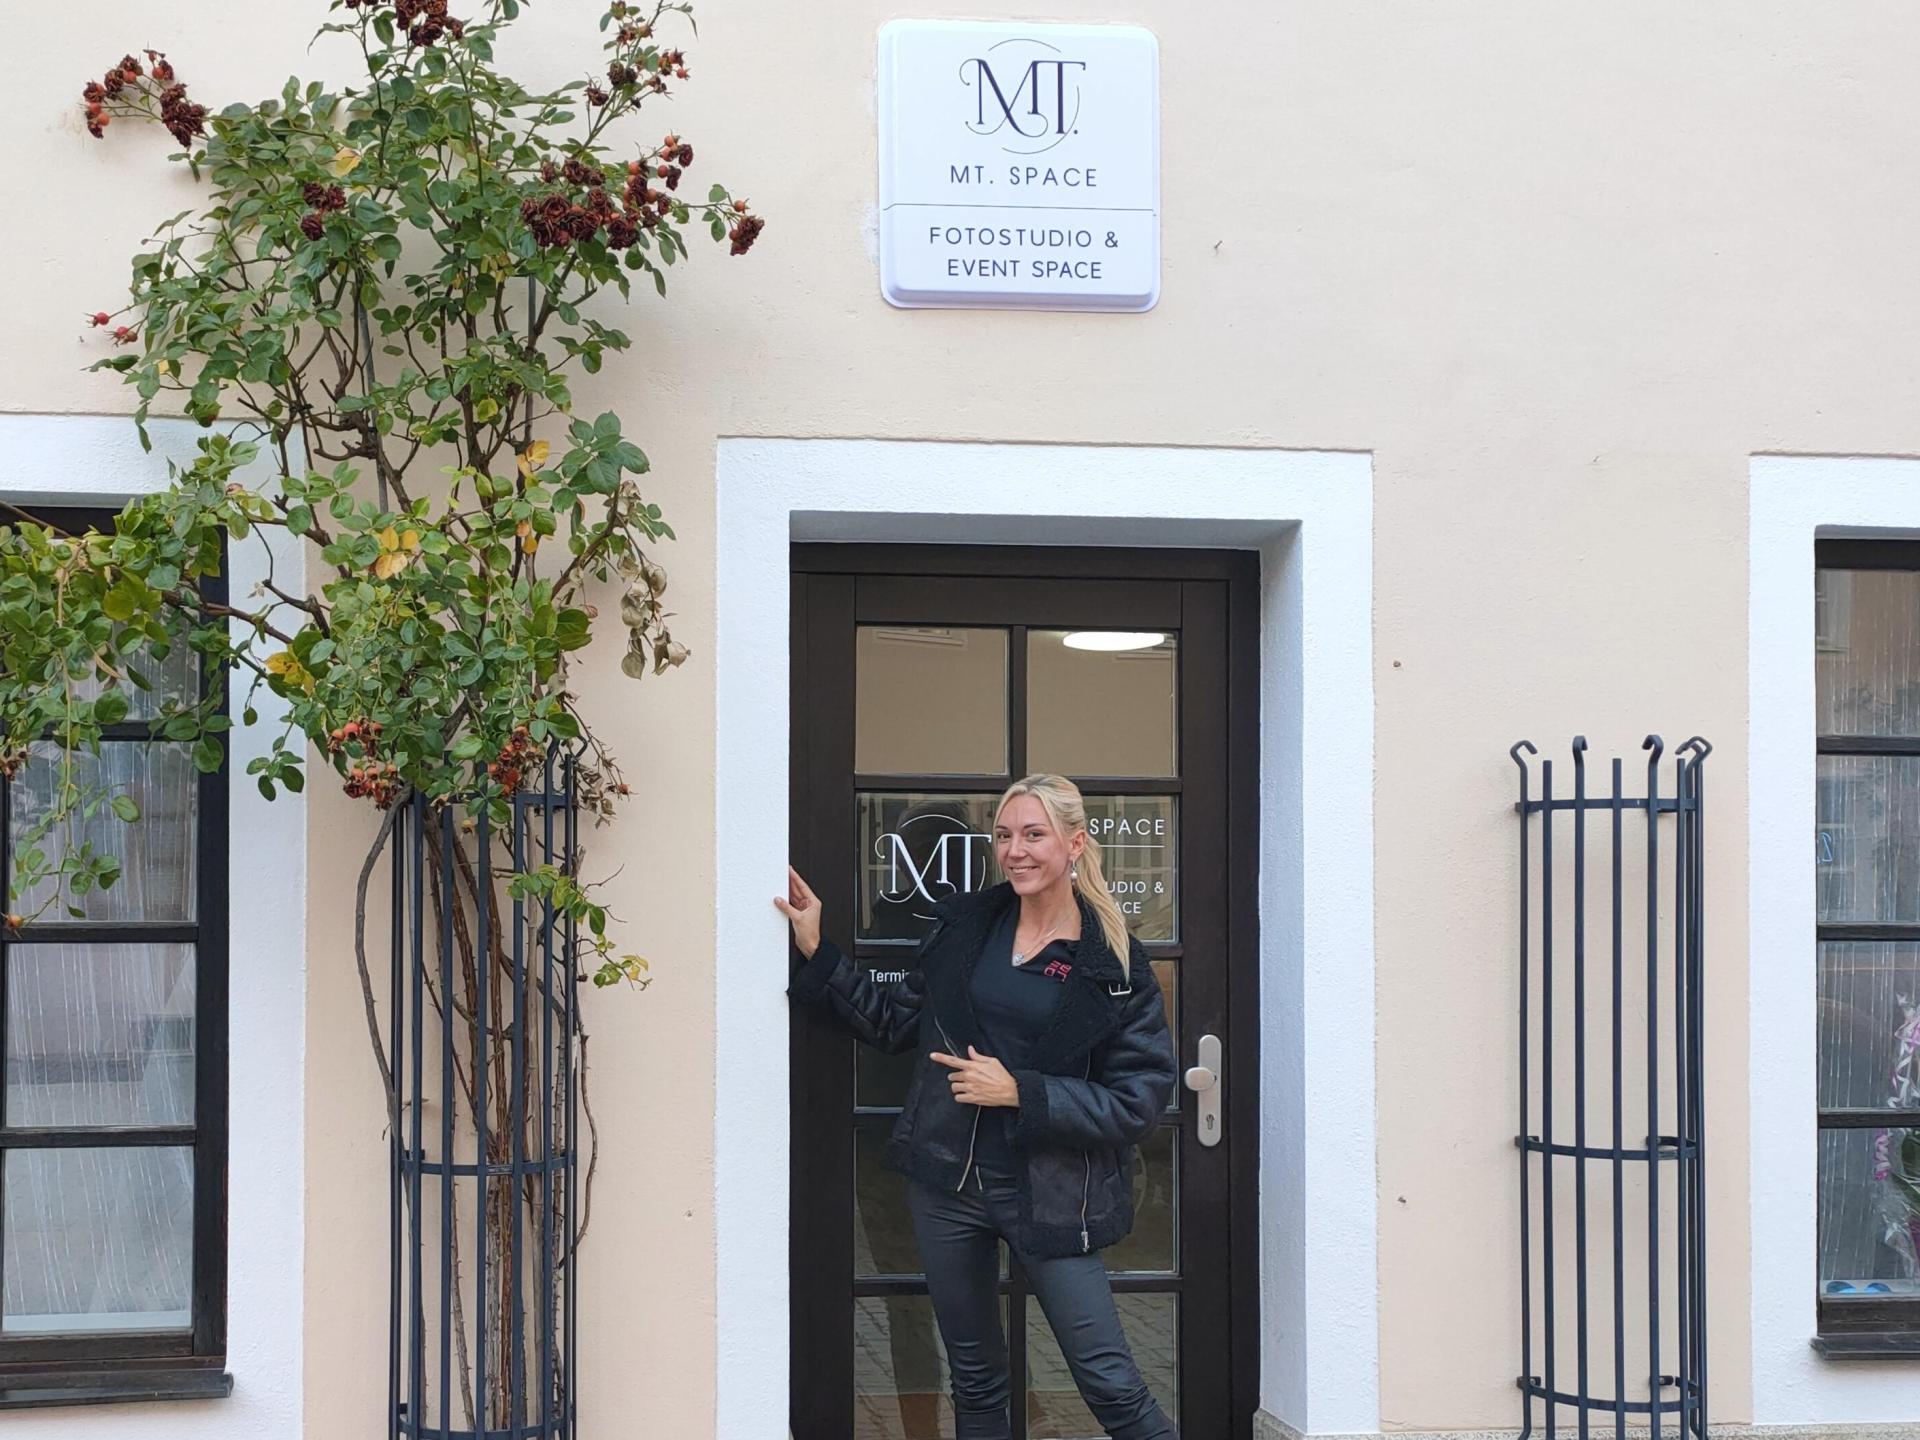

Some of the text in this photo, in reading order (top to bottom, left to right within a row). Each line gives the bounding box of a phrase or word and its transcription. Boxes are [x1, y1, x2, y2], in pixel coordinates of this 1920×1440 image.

[950, 165, 1097, 187] MT. SPACE
[929, 227, 1119, 248] FOTOSTUDIO &
[948, 259, 1102, 279] EVENT SPACE
[1089, 818, 1165, 835] SPACE
[1153, 881, 1164, 894] &
[869, 969, 909, 982] Termi
